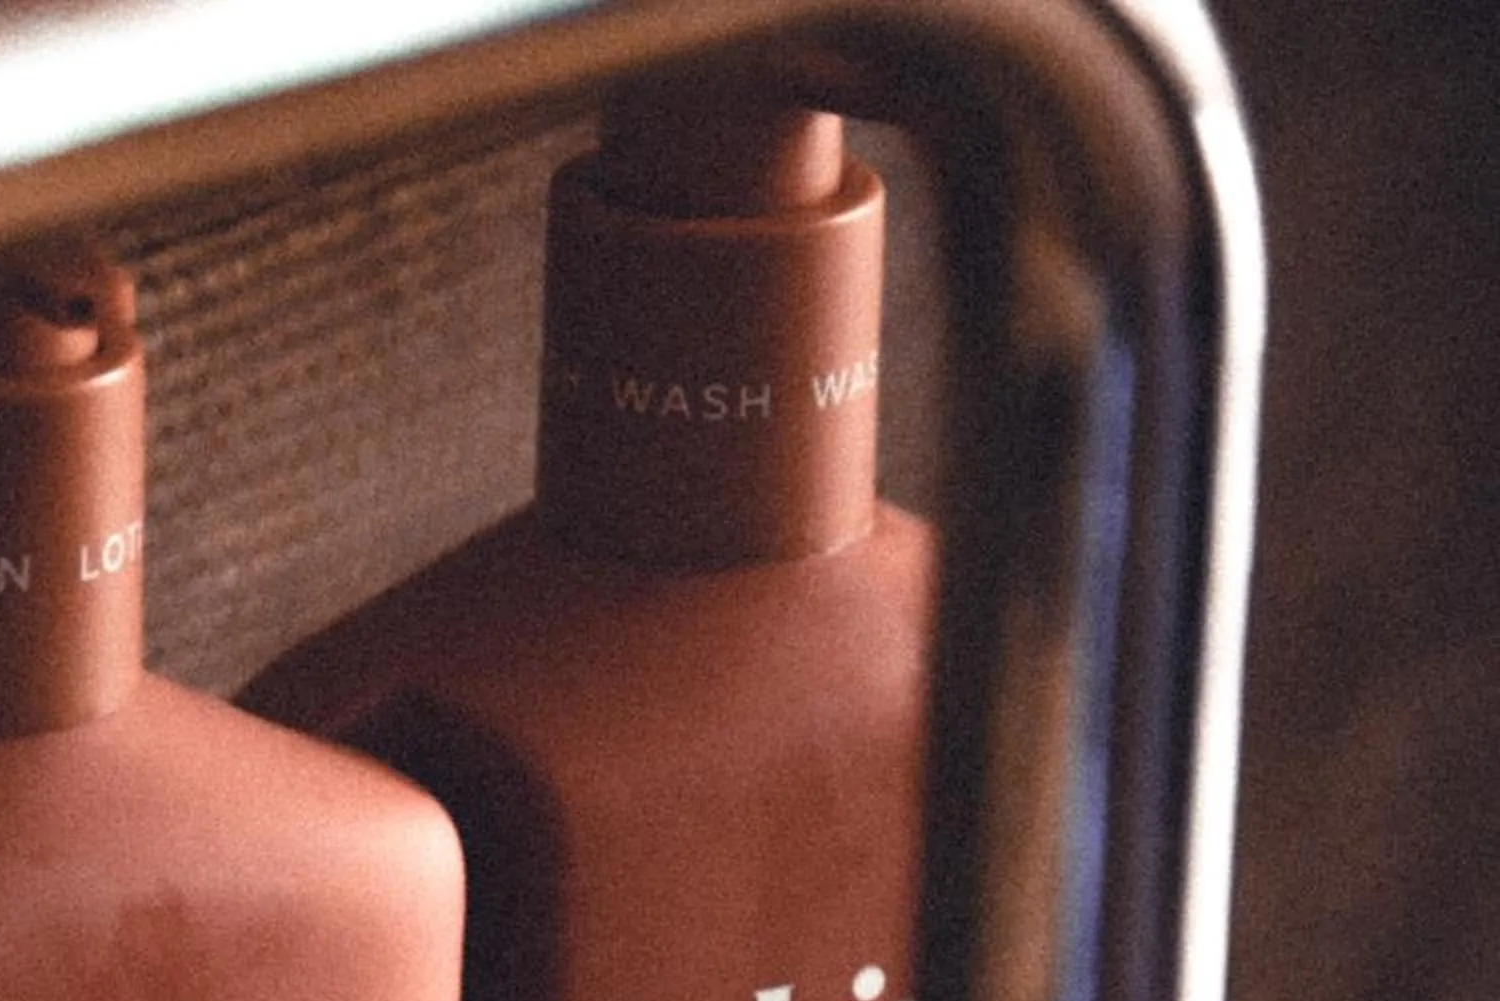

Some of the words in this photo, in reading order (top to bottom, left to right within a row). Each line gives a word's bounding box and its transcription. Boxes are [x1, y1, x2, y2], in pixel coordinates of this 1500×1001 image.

[610, 372, 773, 421] WASH
[810, 348, 877, 411] WAS
[80, 520, 143, 582] LOT
